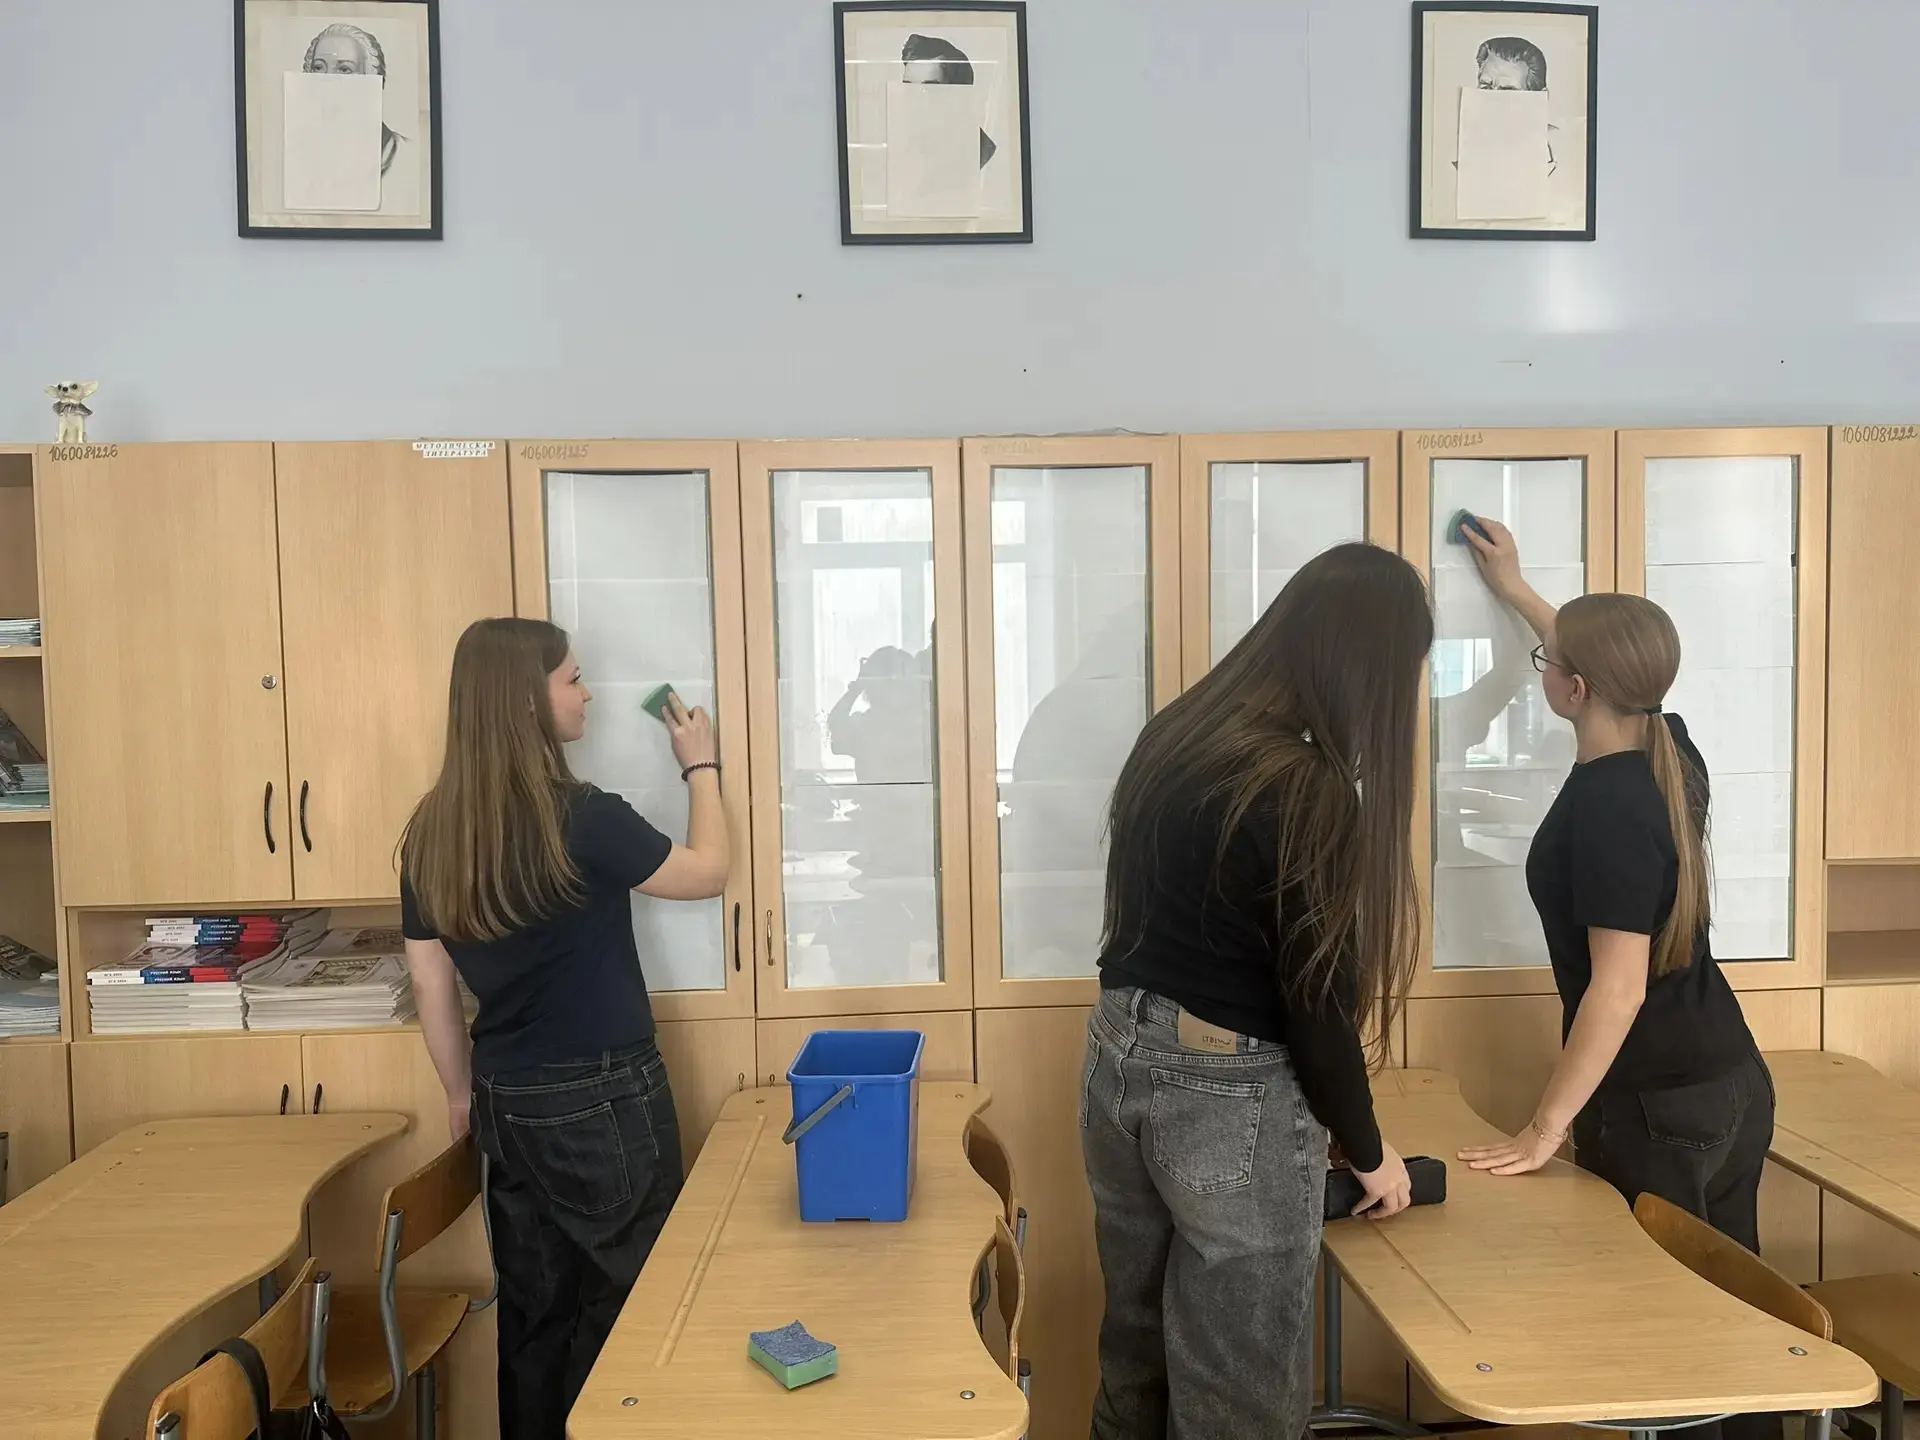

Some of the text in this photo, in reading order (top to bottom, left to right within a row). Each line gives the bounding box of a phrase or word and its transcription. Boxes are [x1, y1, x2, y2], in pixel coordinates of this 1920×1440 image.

[1842, 425, 1918, 443] 1060081222
[49, 444, 118, 462] 1060081226
[416, 442, 494, 450] МЕТОДИЧЕСКАЯ
